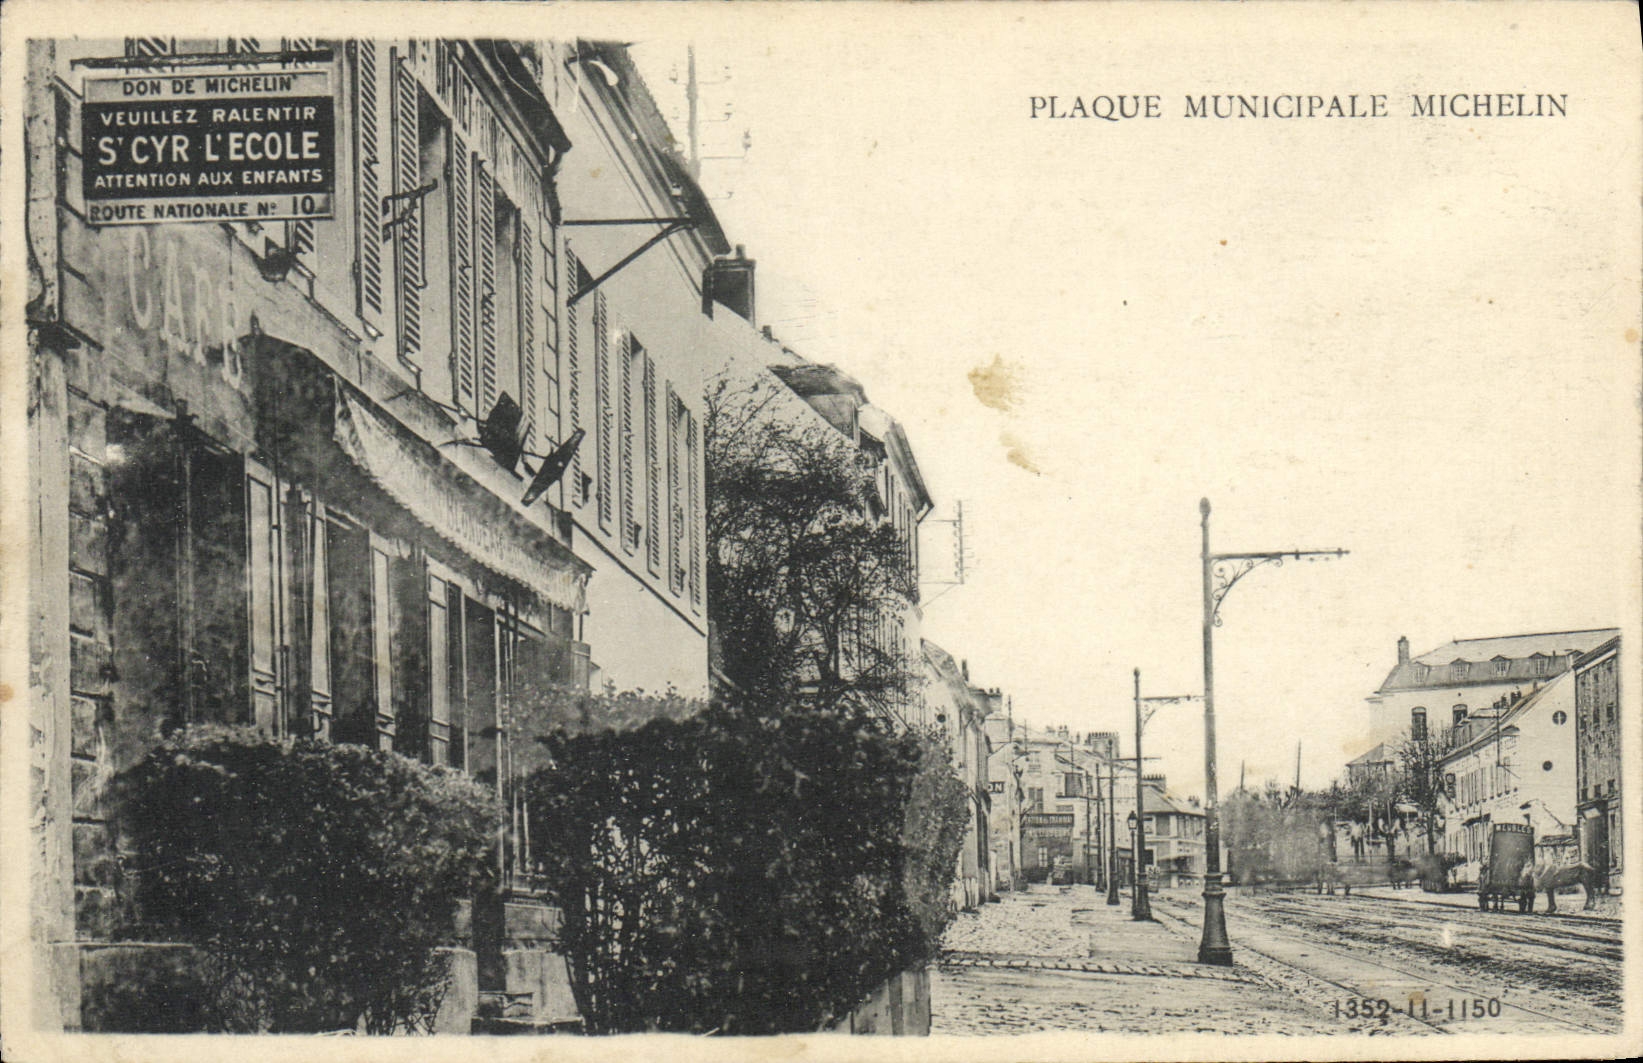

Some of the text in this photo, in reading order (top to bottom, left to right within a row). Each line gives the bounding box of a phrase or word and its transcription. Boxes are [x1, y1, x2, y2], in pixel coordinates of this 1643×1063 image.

[123, 76, 293, 96] DON DE MICHELIN
[100, 106, 316, 126] VEUILLEZ RALENTIR
[131, 134, 190, 164] CYR
[205, 131, 320, 162] L'ECOLE
[94, 168, 323, 188] ATTENTION AUX ENFANTS
[90, 202, 146, 221] ROUTE
[154, 201, 249, 218] NATIONALE
[292, 195, 316, 215] 10
